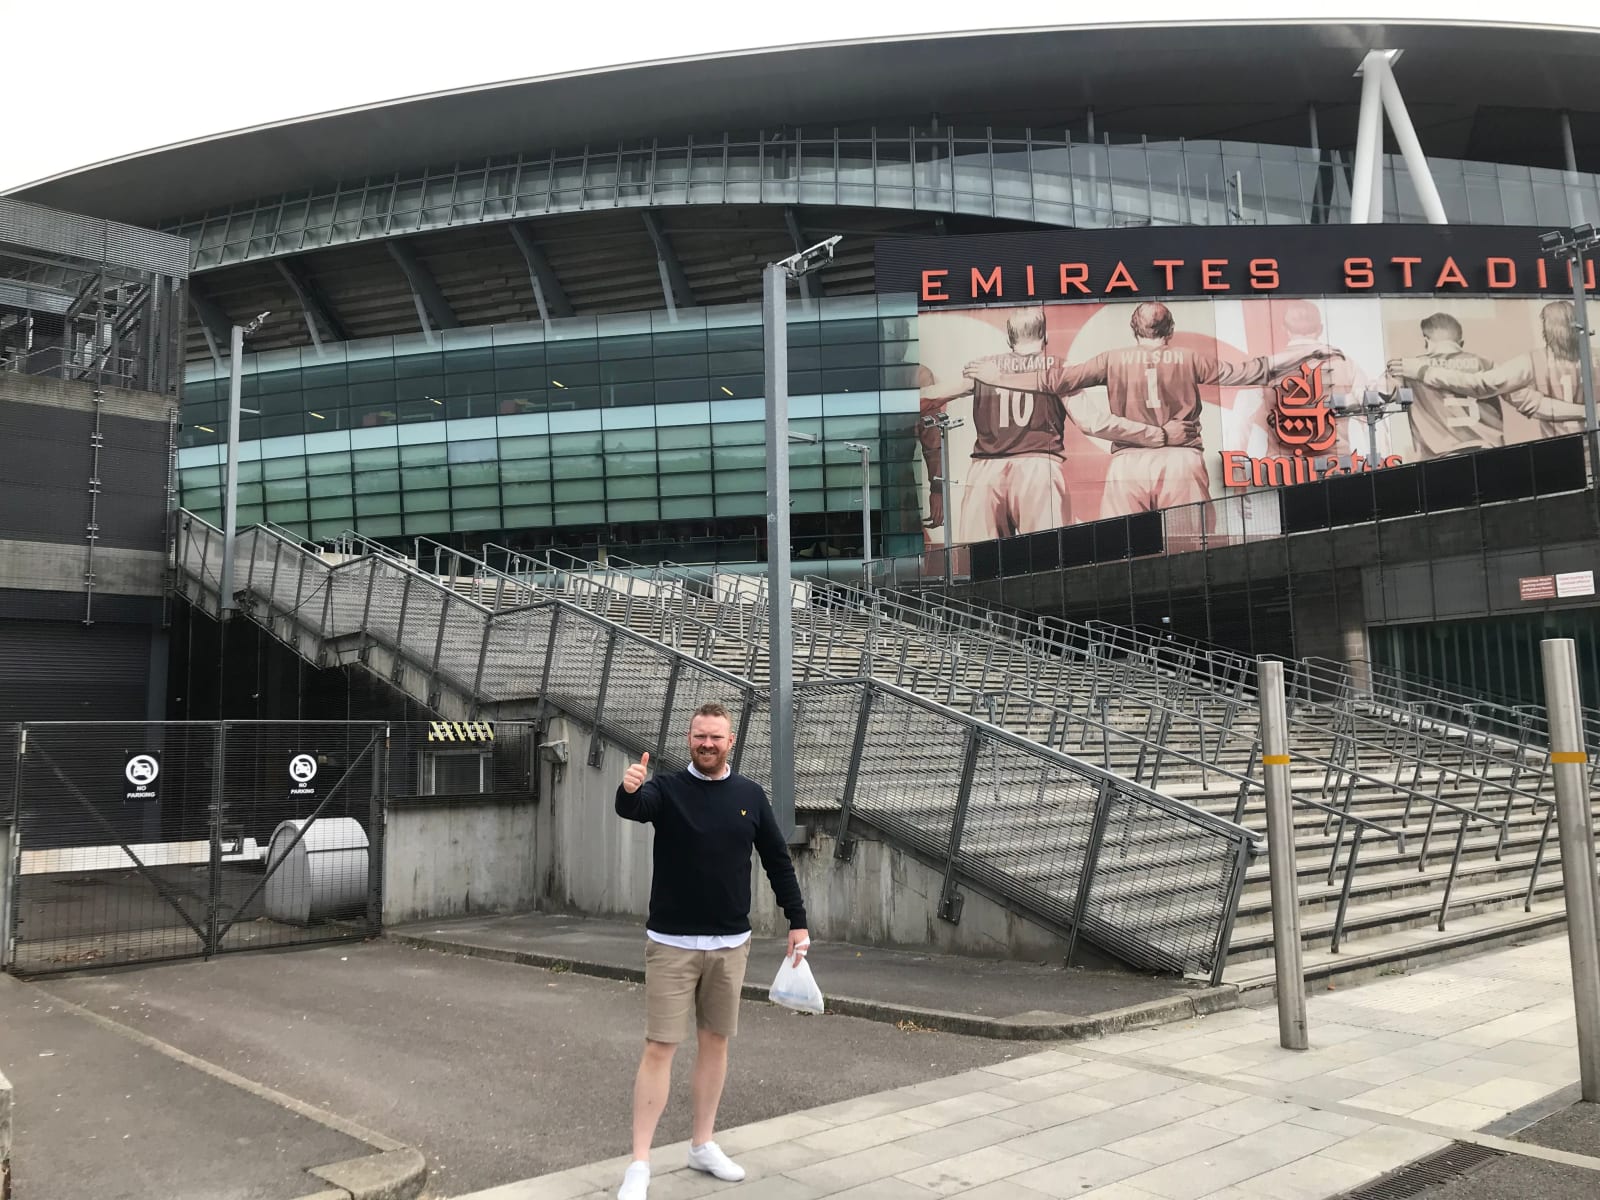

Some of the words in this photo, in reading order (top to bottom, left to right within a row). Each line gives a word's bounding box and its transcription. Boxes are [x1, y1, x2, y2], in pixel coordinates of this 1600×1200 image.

[921, 257, 1281, 301] EMIRATES
[1121, 350, 1184, 366] WILSON
[996, 387, 1035, 429] 10
[1144, 368, 1162, 409] 1
[126, 791, 156, 799] PARKING
